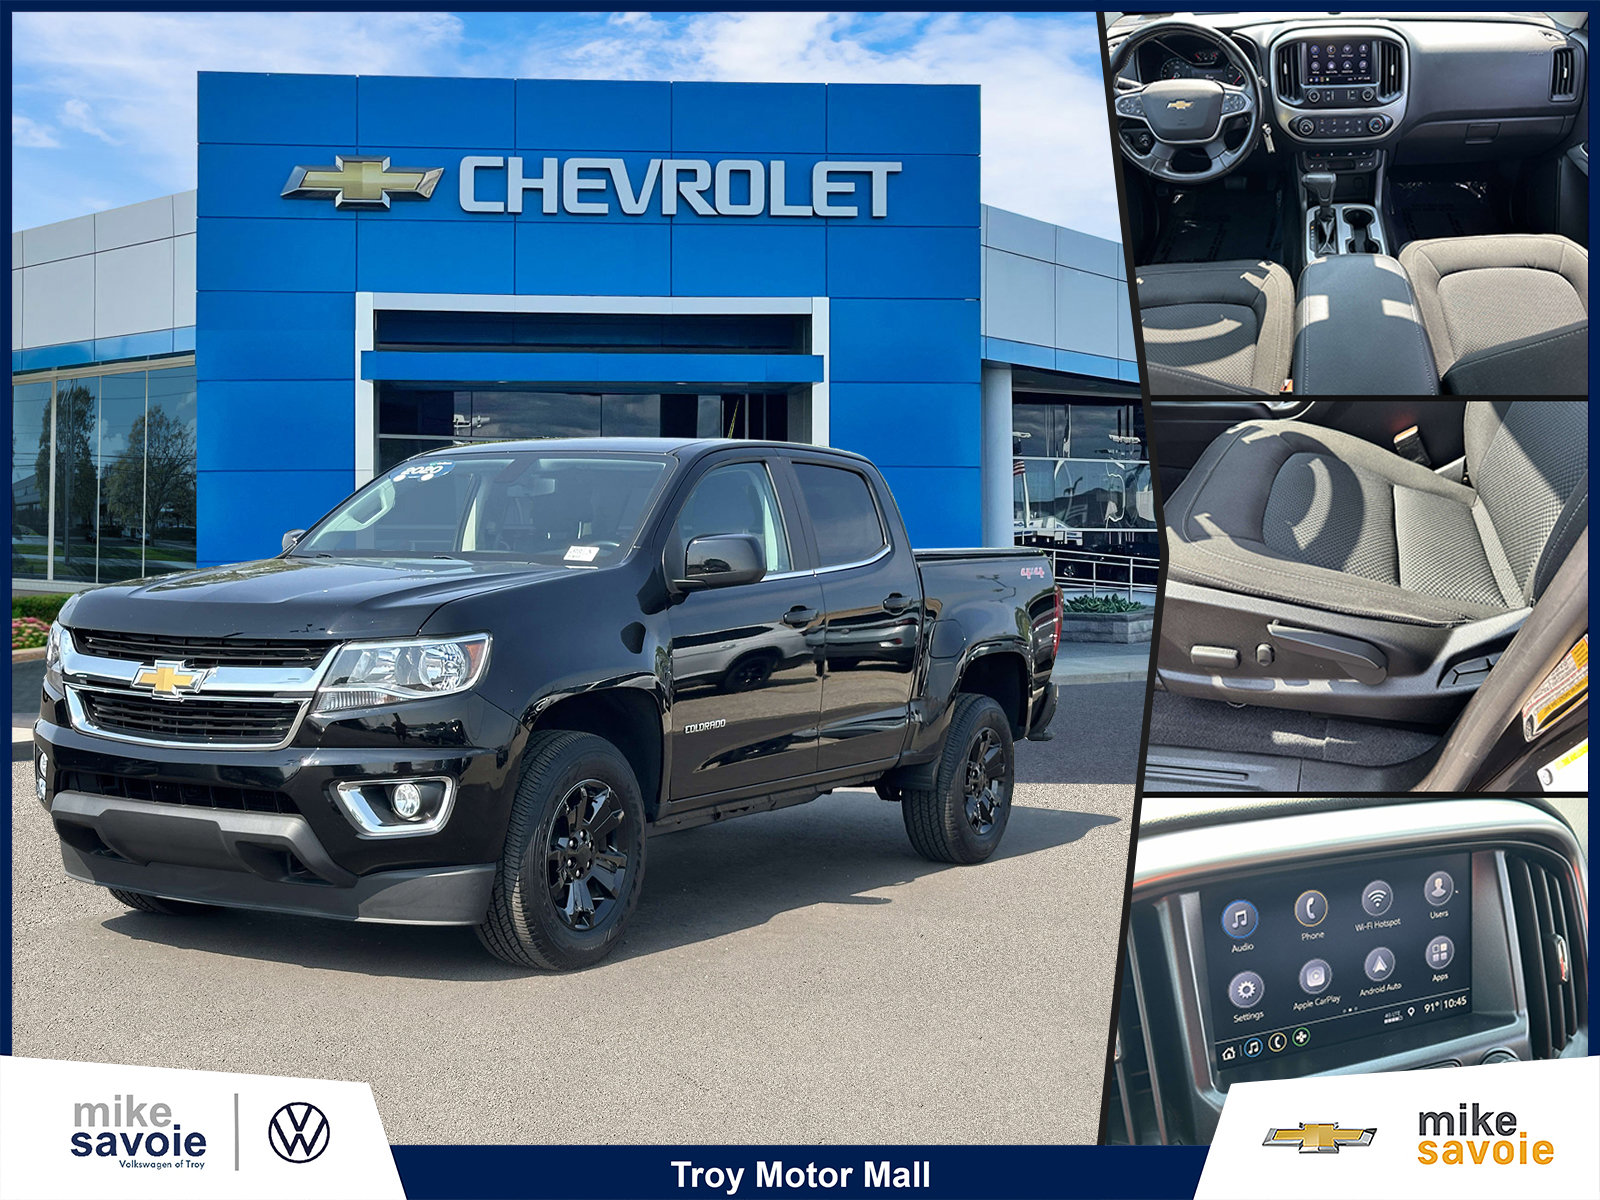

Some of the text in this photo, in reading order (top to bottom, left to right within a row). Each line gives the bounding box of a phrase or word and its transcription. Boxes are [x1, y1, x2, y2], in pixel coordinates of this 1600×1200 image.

[459, 156, 903, 218] CHEVROLET
[400, 465, 444, 475] 2020
[685, 718, 726, 734] COLORADO
[1429, 910, 1449, 919] Users
[1355, 918, 1401, 932] Wi-Fi Hotspot
[1301, 931, 1325, 942] Phone
[1231, 943, 1255, 953] Audio
[1432, 973, 1449, 982] Apps
[1359, 983, 1402, 997] Android Auto
[1293, 995, 1341, 1011] Apple CarPlay
[1443, 995, 1468, 1009] 10:45
[1233, 1010, 1265, 1023] Settings
